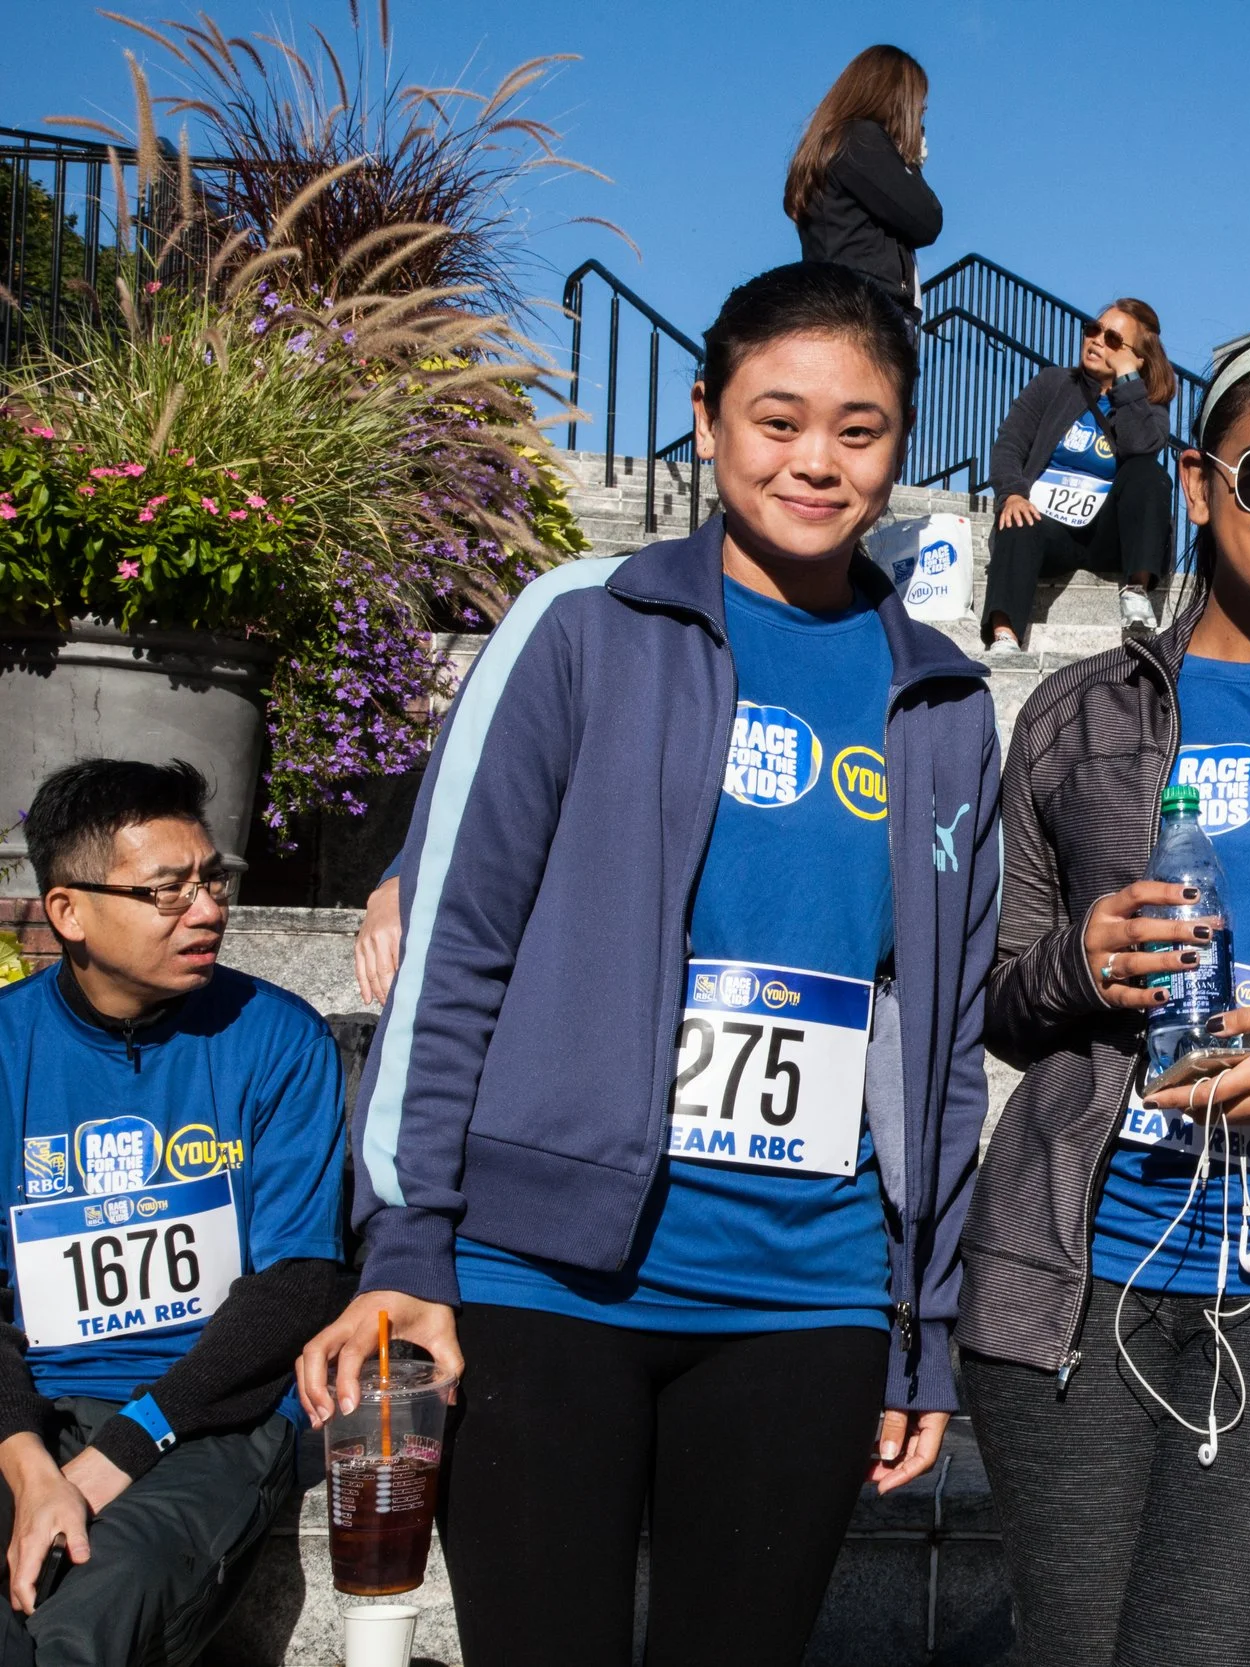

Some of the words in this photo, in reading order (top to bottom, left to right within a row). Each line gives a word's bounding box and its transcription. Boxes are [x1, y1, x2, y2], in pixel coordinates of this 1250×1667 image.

[1045, 510, 1068, 522] TEAM
[1047, 487, 1097, 517] 1226
[925, 544, 950, 560] RACE
[731, 718, 798, 759] RACE
[728, 748, 763, 769] FOR
[766, 753, 798, 776] THE
[1178, 757, 1250, 783] RACE
[725, 763, 798, 801] KIDS
[1216, 782, 1249, 799] THE
[86, 1130, 143, 1158] RACE
[748, 1134, 805, 1163] RBC
[86, 1158, 111, 1173] FOR
[114, 1156, 143, 1170] THE
[28, 1177, 64, 1193] RBC
[86, 1170, 144, 1194] KIDS
[63, 1223, 200, 1312] 1676
[78, 1308, 146, 1337] TEAM
[155, 1297, 202, 1323] RBC
